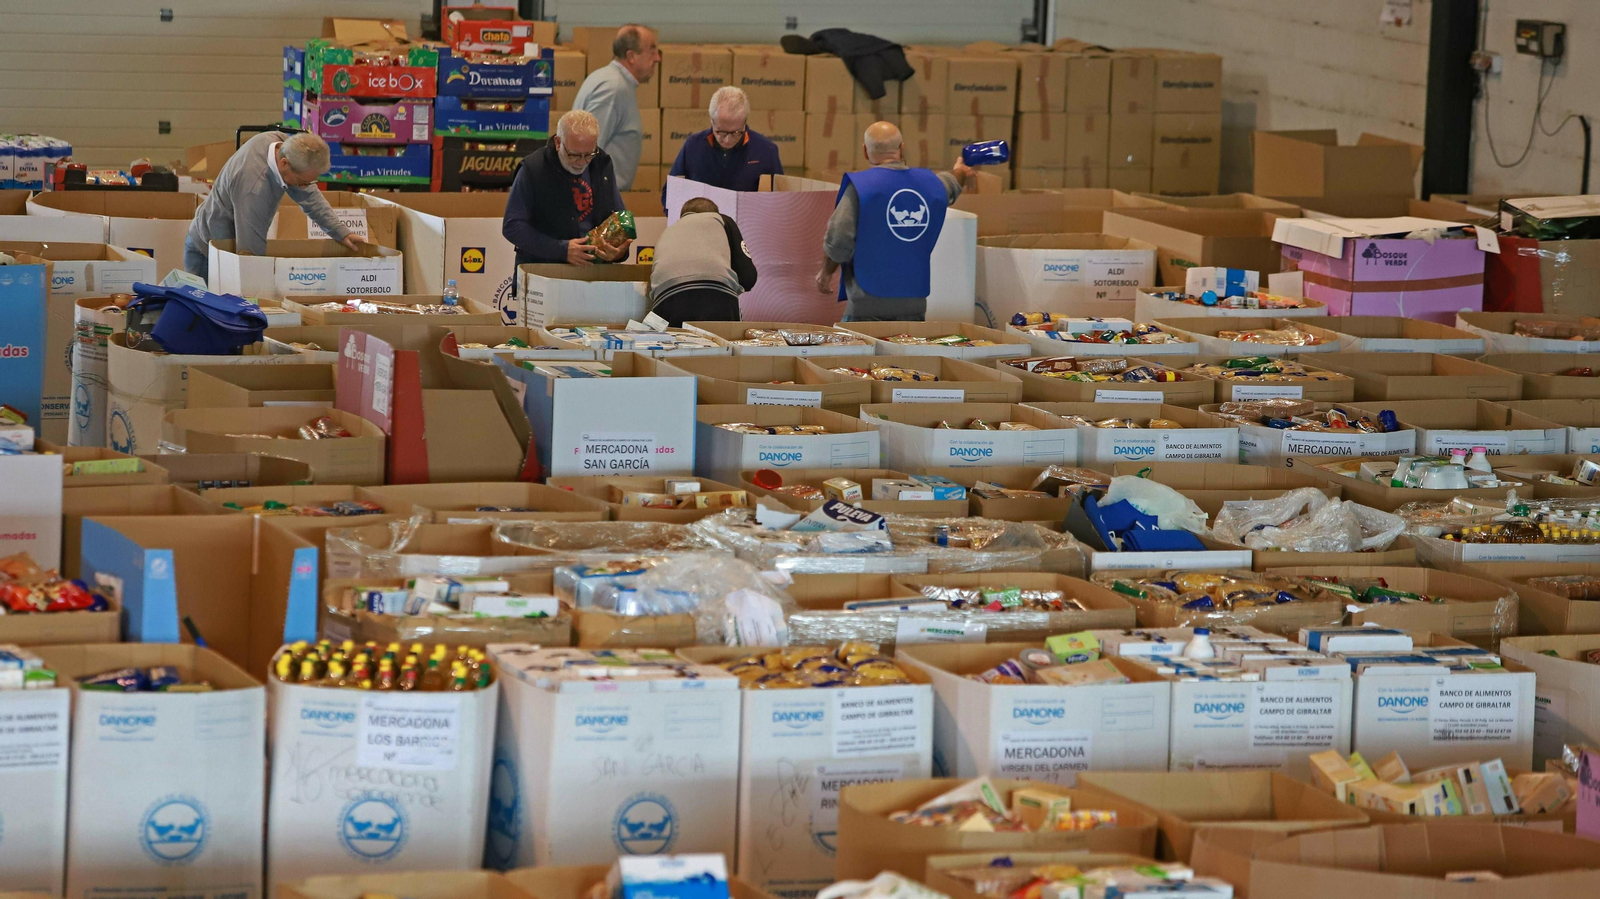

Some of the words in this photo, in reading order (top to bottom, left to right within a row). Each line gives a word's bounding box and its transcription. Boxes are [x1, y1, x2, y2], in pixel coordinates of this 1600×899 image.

[479, 123, 493, 131] Las
[496, 122, 530, 131] Virtudes
[360, 169, 374, 177] Las
[378, 168, 411, 176] Virtudes
[1385, 259, 1408, 267] VERDE
[346, 286, 392, 294] SOTOREBOLO
[586, 444, 648, 454] MERCADONA
[950, 447, 993, 457] DANONE
[1114, 446, 1156, 455] DANONE
[1288, 444, 1352, 455] MERCADONA
[759, 452, 802, 462] DANONE
[1361, 452, 1380, 460] BANCO
[1388, 449, 1410, 458] ALIMENTOS
[584, 459, 606, 470] SAN
[610, 457, 650, 470] GARCÍA
[829, 502, 874, 523] PULEVA
[803, 518, 827, 528] ENTERA
[926, 627, 965, 636] MERCADONA
[866, 700, 875, 708] DE
[876, 698, 914, 707] ALIMENTOS
[1378, 696, 1428, 708] DANONE
[1013, 708, 1065, 718] DANONE
[1194, 702, 1244, 714] DANONE
[772, 711, 824, 722] DANONE
[841, 713, 866, 721] CAMPO
[867, 712, 878, 720] DE
[878, 708, 914, 718] GIBRALTAR
[368, 714, 450, 729] MERCADONA
[368, 734, 391, 746] LOS
[1005, 746, 1085, 760] MERCADONA
[1002, 764, 1032, 773] VIRGEN
[1035, 764, 1050, 773] DEL
[1053, 763, 1088, 772] CARMEN
